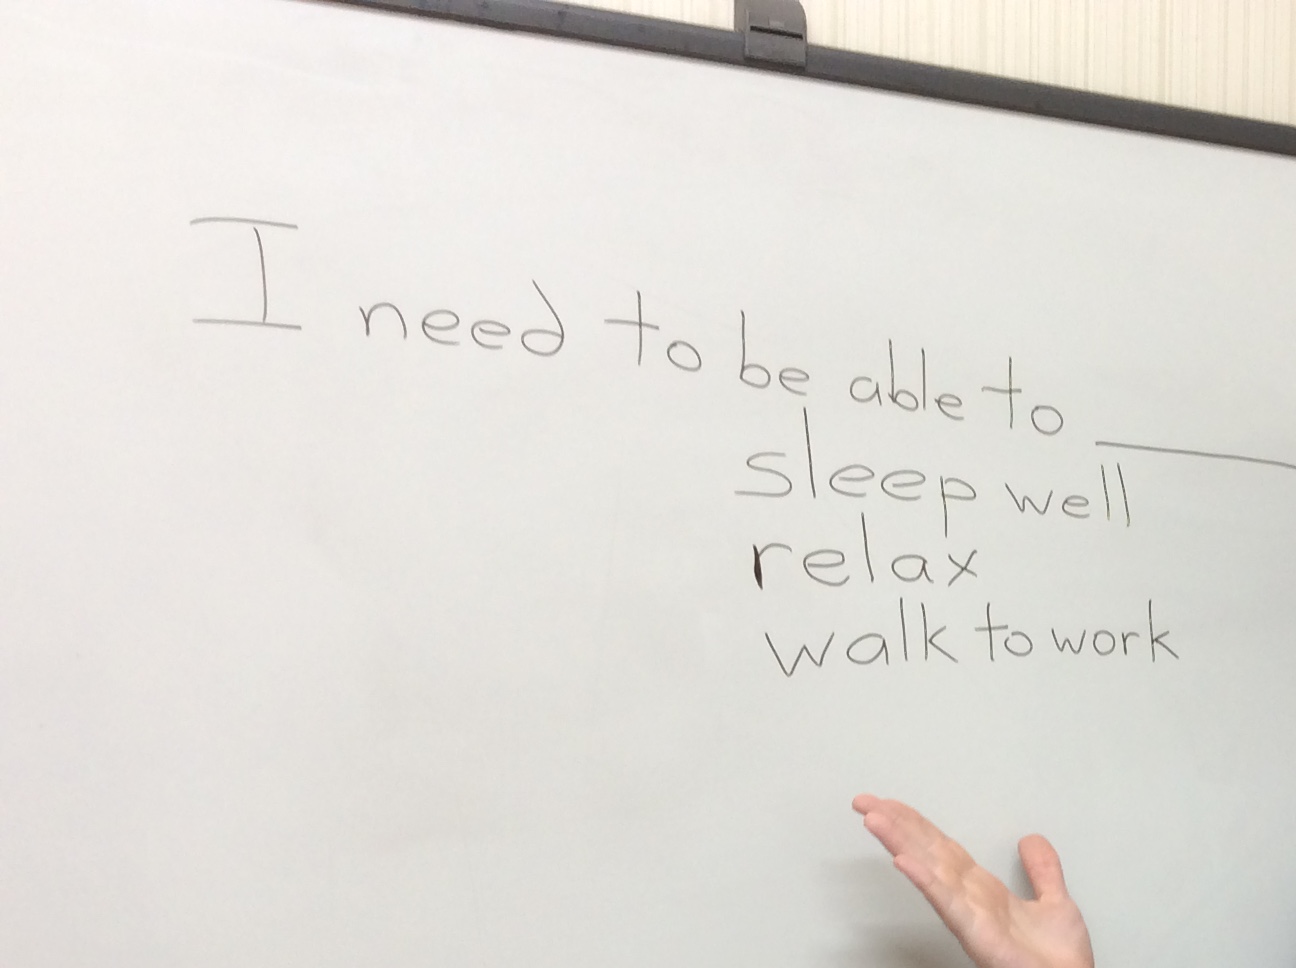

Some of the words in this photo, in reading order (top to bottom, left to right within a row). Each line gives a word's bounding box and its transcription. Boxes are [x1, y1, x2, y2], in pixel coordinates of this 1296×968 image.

[189, 216, 302, 331] I
[359, 278, 565, 357] need
[604, 290, 702, 372] to
[740, 310, 810, 396] be
[849, 339, 965, 421] able
[981, 356, 1064, 435] to
[735, 406, 977, 538] sleep
[1005, 462, 1131, 528] well
[752, 512, 978, 590] relax
[765, 596, 958, 678] walk
[974, 602, 1034, 662] to
[1051, 599, 1180, 663] work
